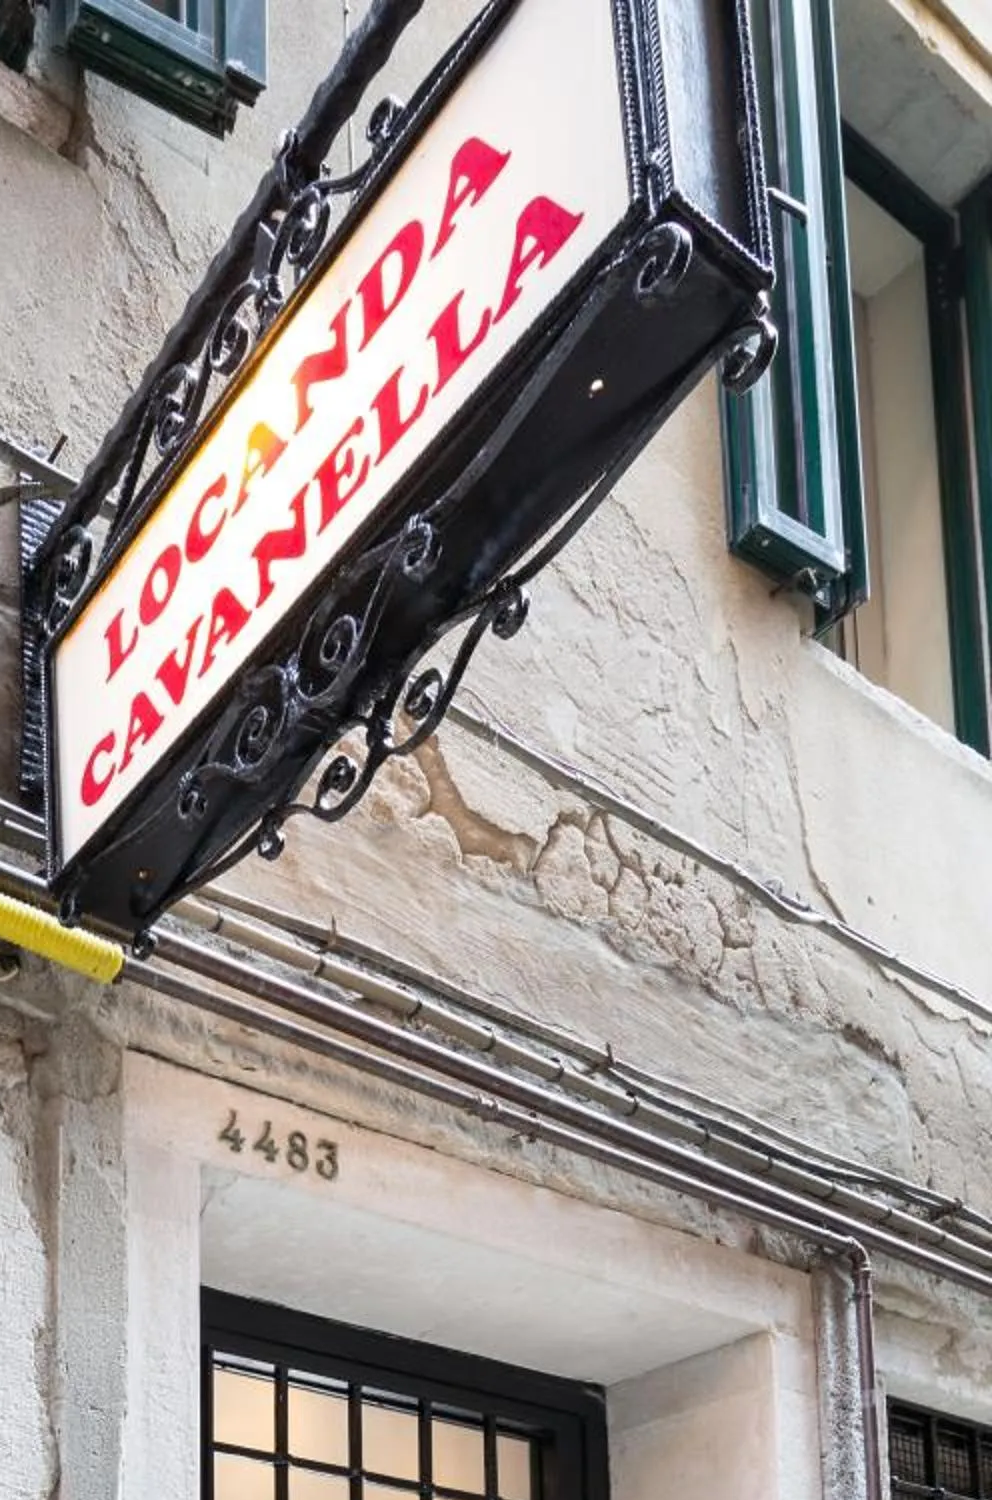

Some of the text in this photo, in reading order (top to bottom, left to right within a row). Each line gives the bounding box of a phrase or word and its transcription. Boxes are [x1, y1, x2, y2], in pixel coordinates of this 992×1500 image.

[80, 195, 584, 807] CAVANELLA
[104, 136, 511, 683] LOCANDA
[218, 1108, 339, 1181] 4483
